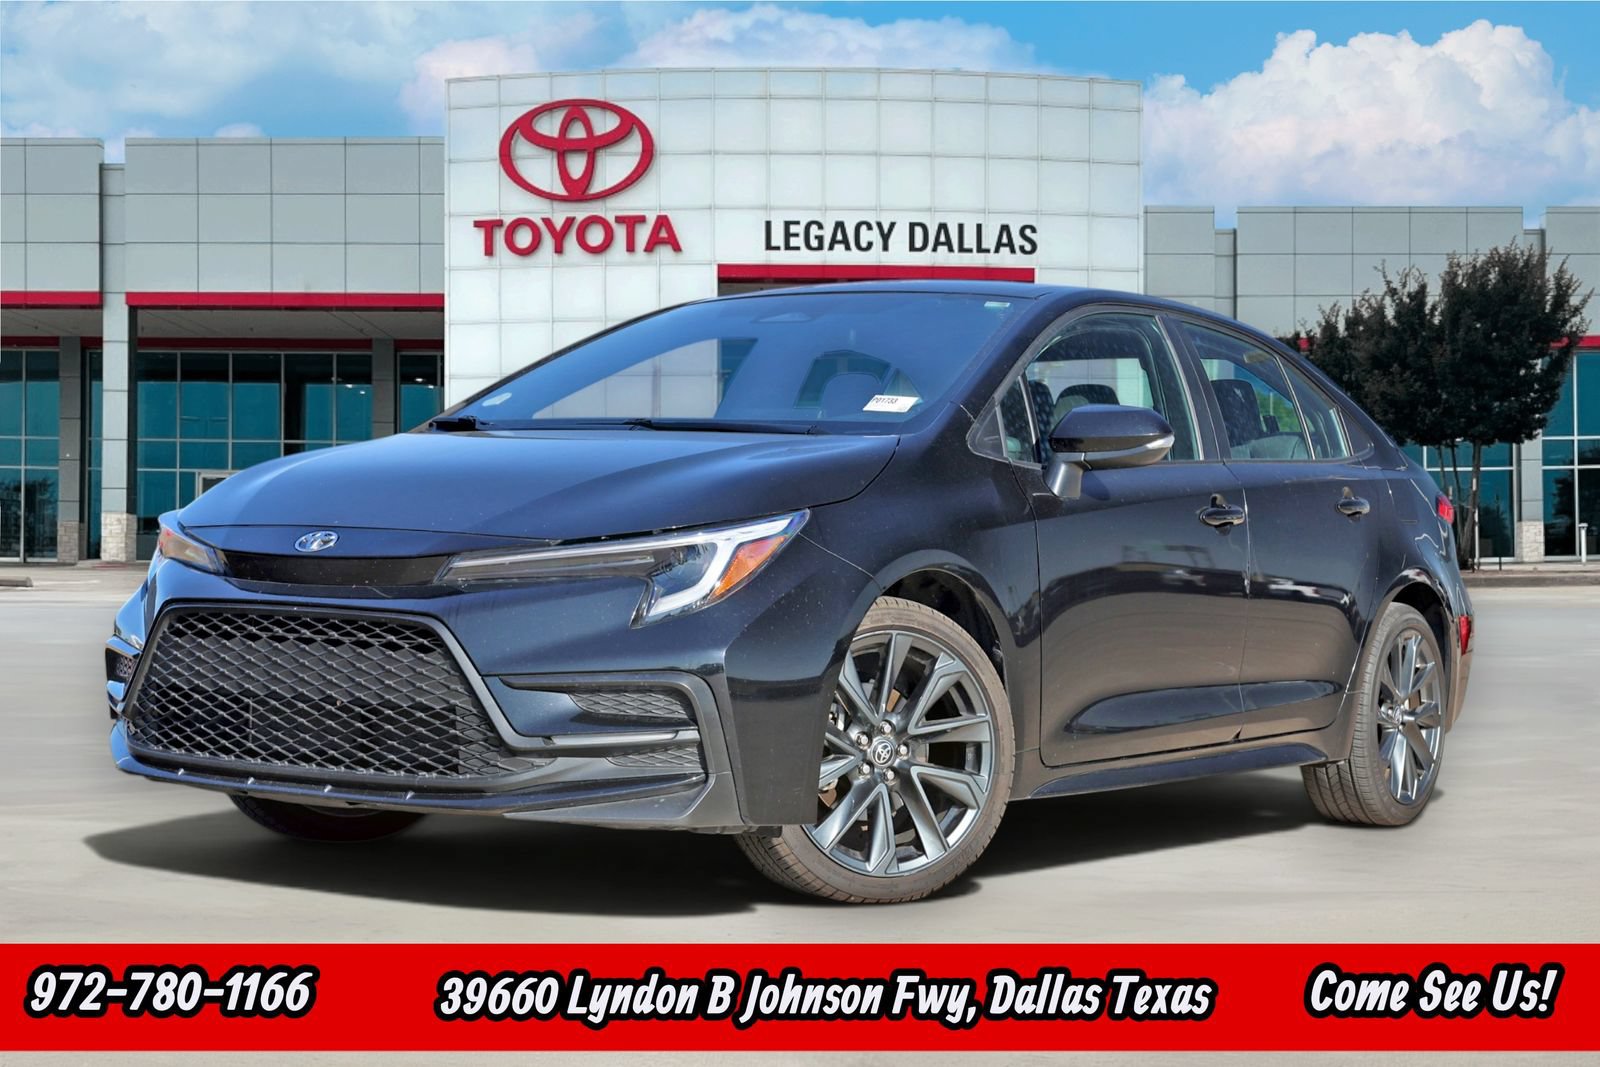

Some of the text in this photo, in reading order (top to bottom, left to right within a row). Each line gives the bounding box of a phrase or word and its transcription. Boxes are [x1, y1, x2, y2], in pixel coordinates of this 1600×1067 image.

[474, 213, 682, 257] TOYOTA
[765, 219, 1038, 255] LEGACY DALLAS
